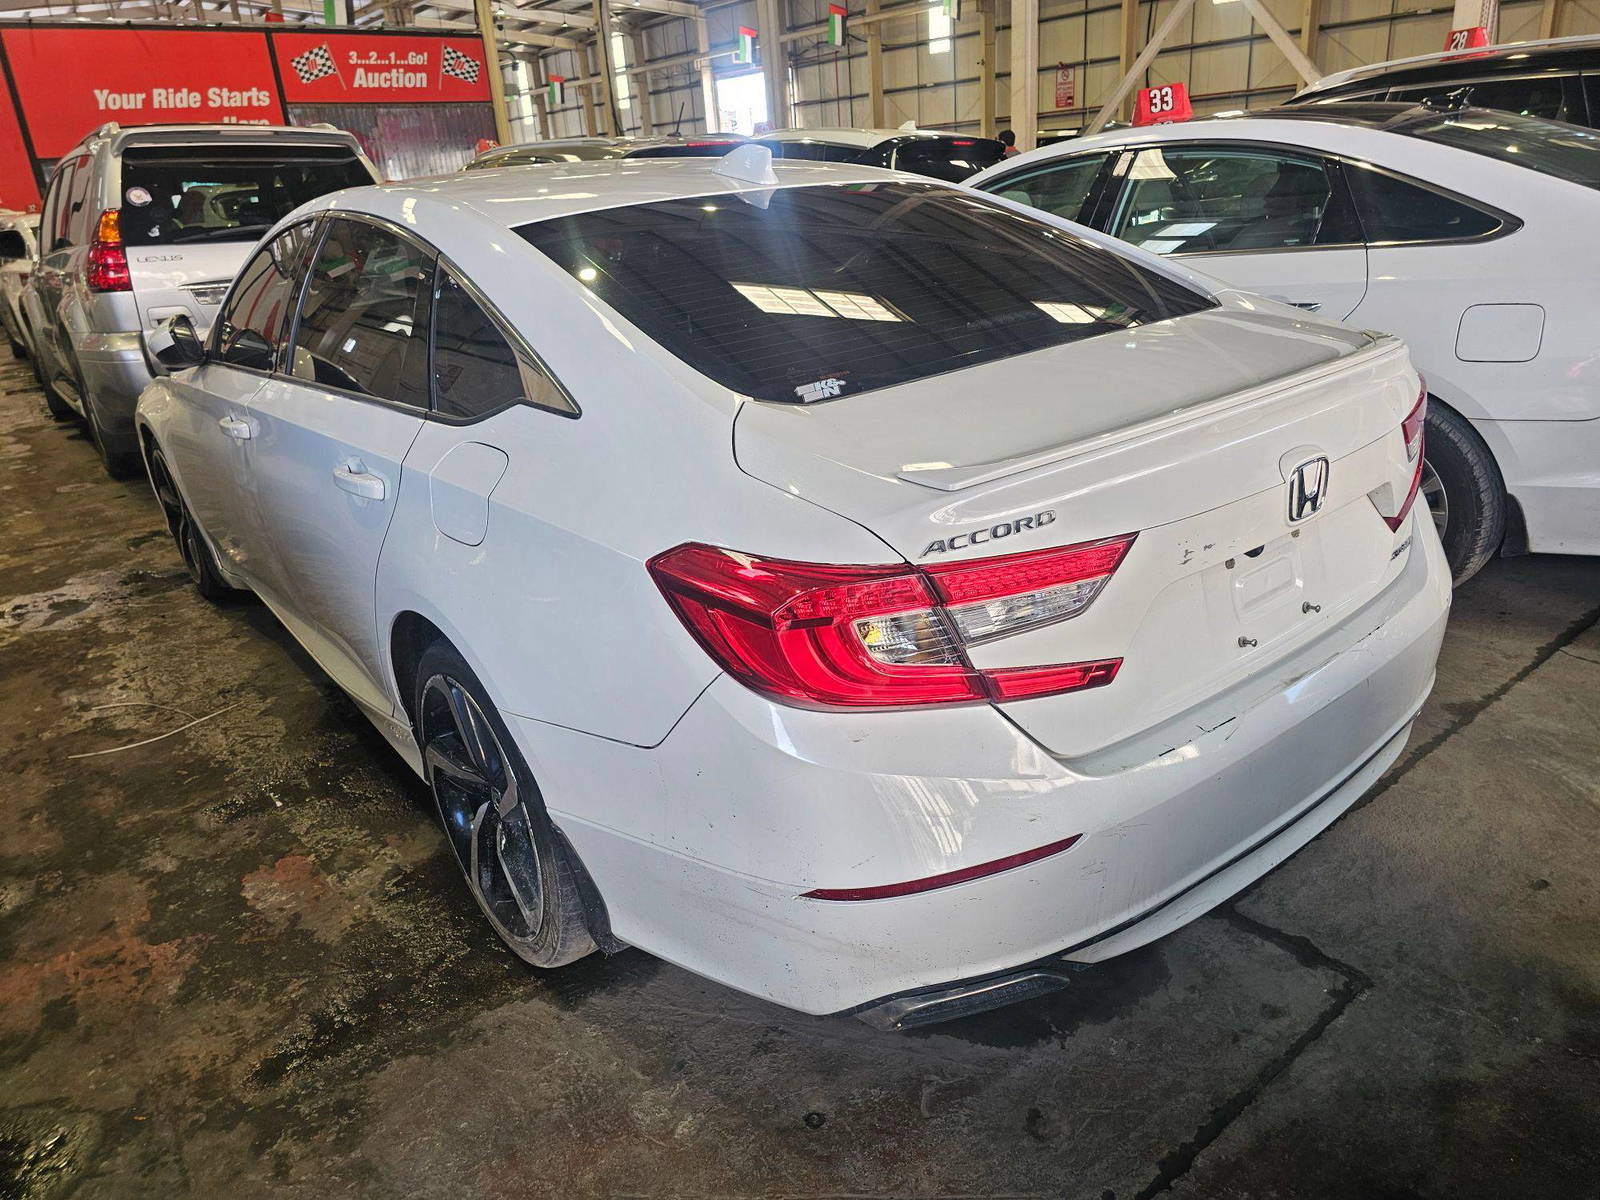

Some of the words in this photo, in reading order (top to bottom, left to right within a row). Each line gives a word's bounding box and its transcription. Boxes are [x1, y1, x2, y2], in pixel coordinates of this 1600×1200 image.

[1450, 31, 1468, 52] 28
[353, 67, 428, 88] Auction
[93, 89, 146, 110] Your
[152, 88, 202, 109] Ride
[207, 87, 271, 108] Starts
[1149, 86, 1174, 113] 33
[918, 509, 1057, 559] ACCORD
